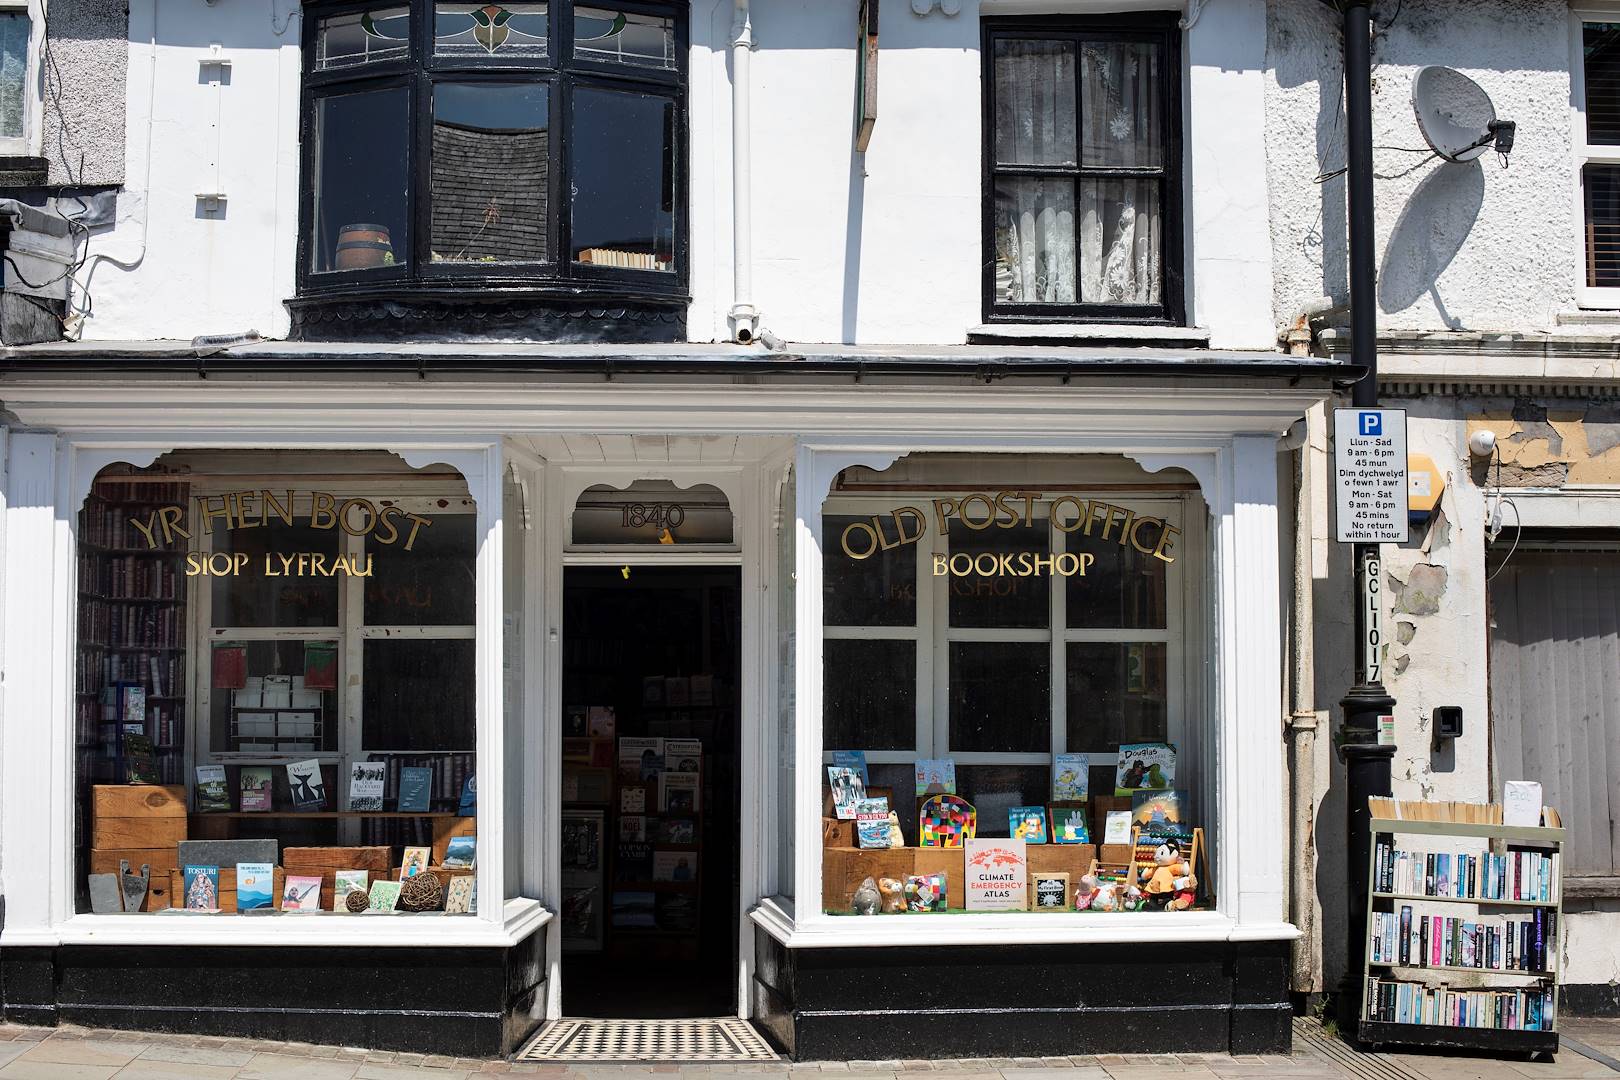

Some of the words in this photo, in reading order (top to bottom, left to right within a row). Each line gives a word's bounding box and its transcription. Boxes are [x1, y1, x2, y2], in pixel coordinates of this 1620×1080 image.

[1364, 414, 1379, 434] P
[1350, 438, 1369, 446] Llun
[1375, 438, 1392, 446] Sad
[1355, 459, 1367, 467] 45
[1339, 469, 1356, 477] Dim
[1358, 469, 1404, 479] dychwelyd
[1352, 478, 1374, 486] fewn
[1352, 490, 1371, 498] Mon
[1377, 490, 1393, 498] Sat
[622, 503, 685, 528] 1840
[1355, 511, 1368, 519] 45
[1369, 511, 1390, 519] mins
[130, 505, 193, 551] YR
[196, 489, 296, 536] HEN
[310, 491, 433, 552] BOST
[841, 506, 927, 561] OLD
[932, 490, 1043, 536] POST
[1049, 495, 1183, 564] OFFICE
[1351, 521, 1365, 529] No
[1367, 521, 1394, 529] return
[1345, 530, 1372, 538] within
[1380, 530, 1401, 538] hour
[185, 551, 249, 577] SIOP
[264, 551, 374, 578] LYFRAU
[931, 551, 1095, 577] BOOKSHOP
[984, 890, 1010, 898] ATLAS
